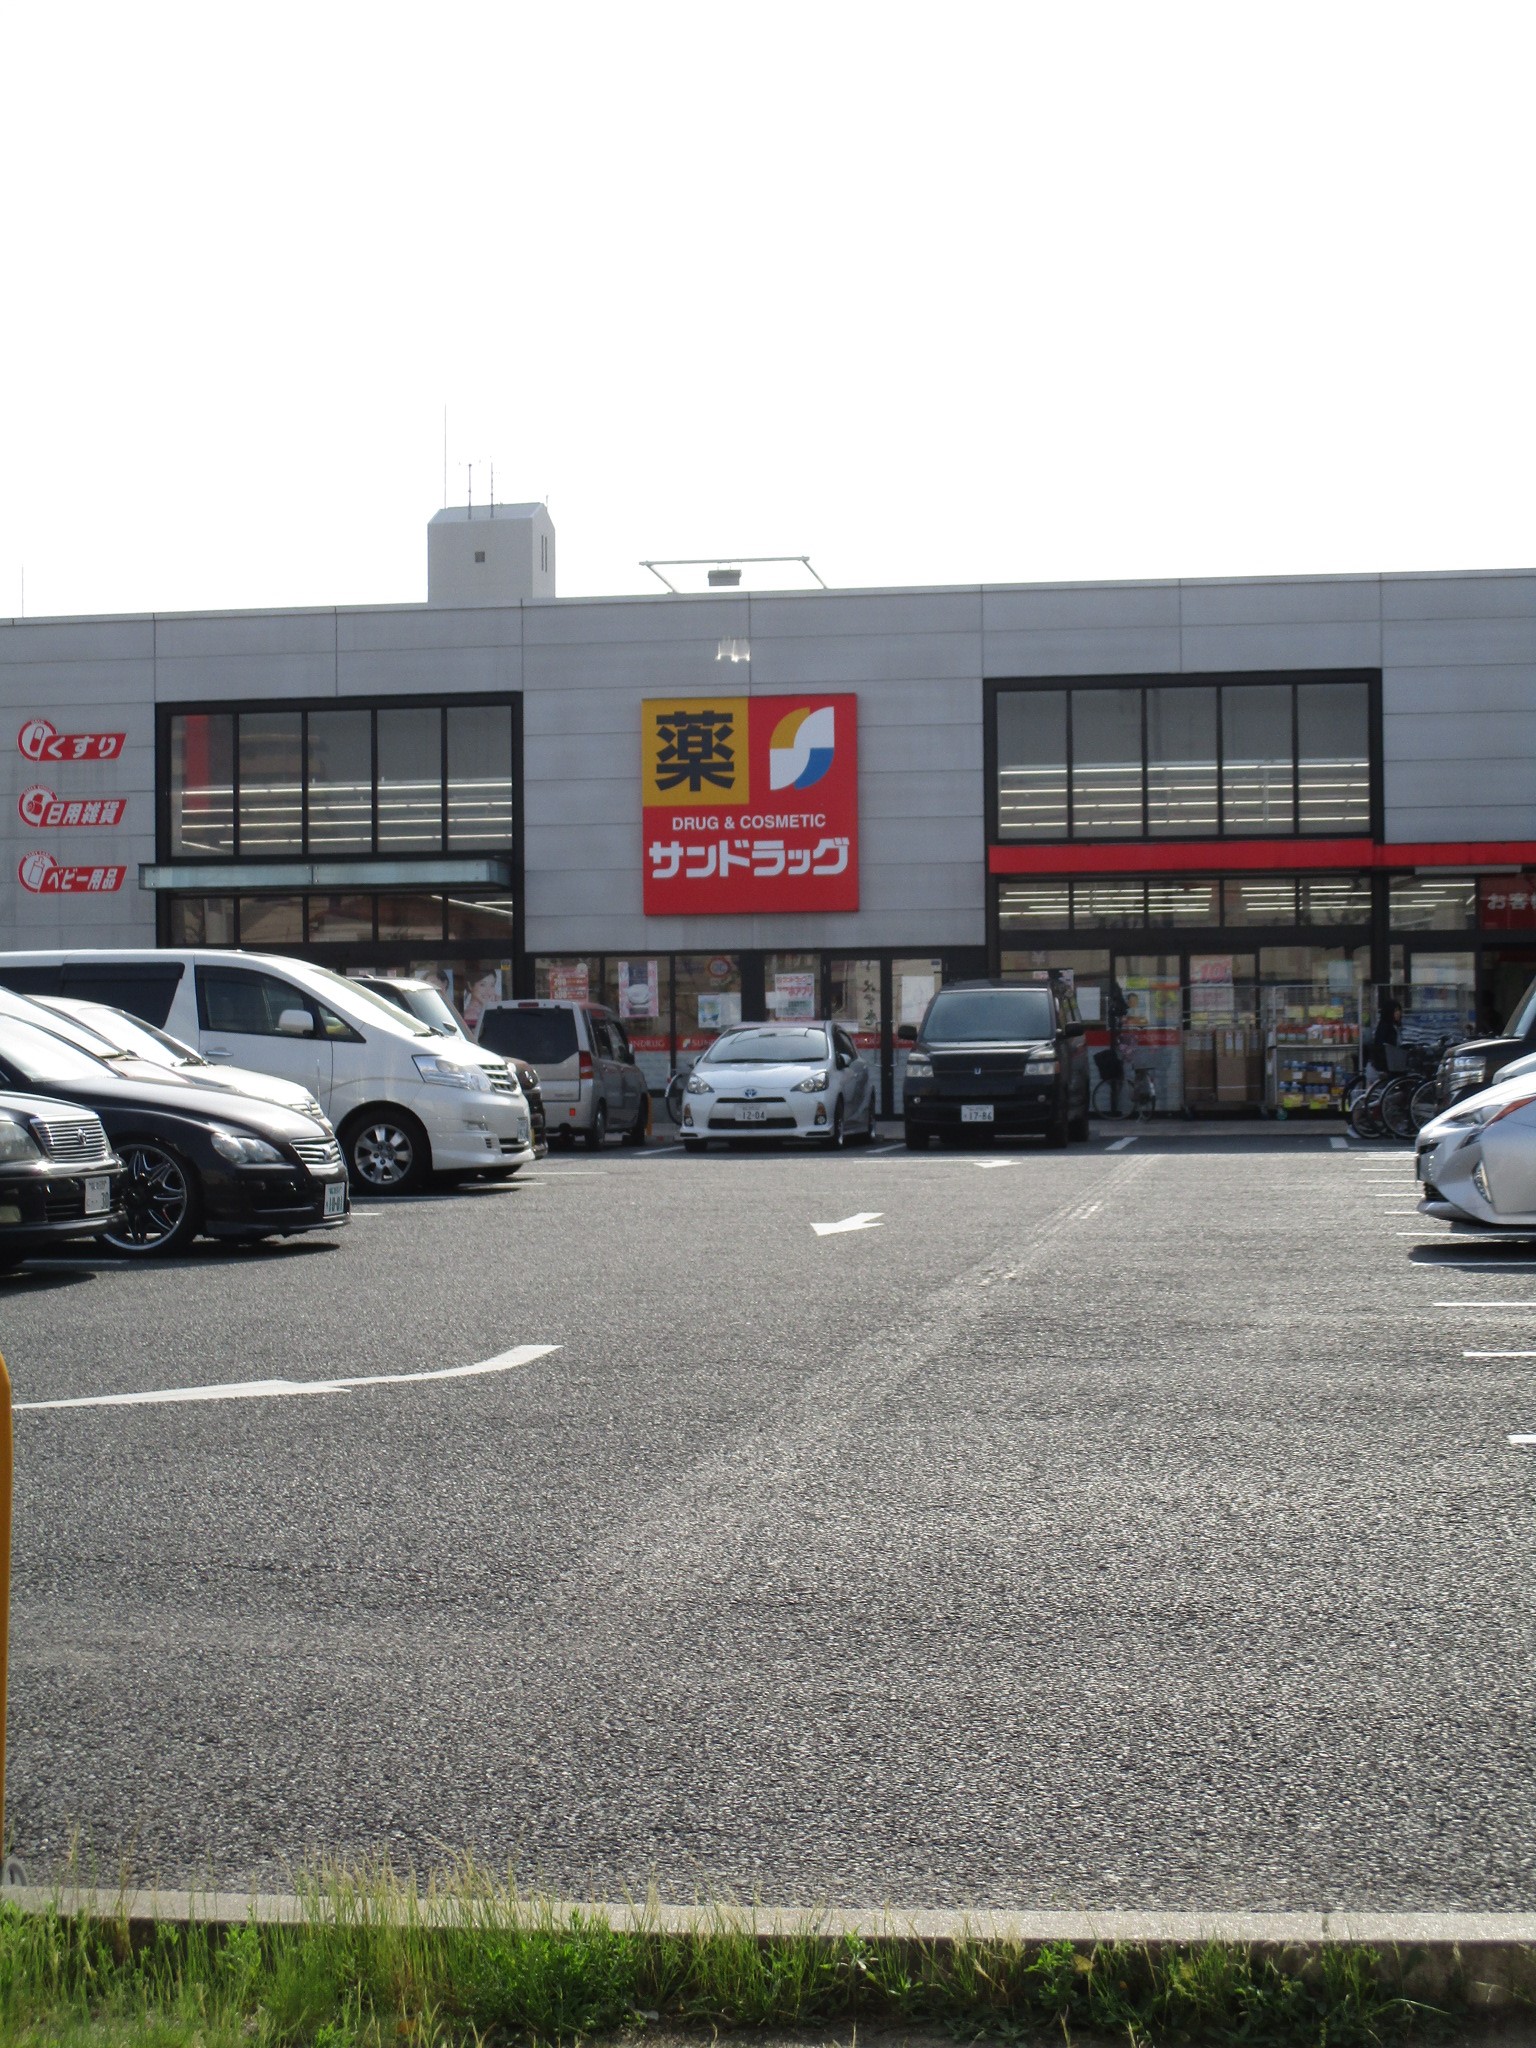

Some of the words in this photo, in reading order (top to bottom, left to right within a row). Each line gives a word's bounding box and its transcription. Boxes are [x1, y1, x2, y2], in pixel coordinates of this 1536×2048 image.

[47, 735, 117, 759] くすり
[654, 710, 736, 792] 薬
[46, 801, 120, 825] 日用雑貨
[672, 816, 719, 831] DRUG
[724, 816, 736, 830] &
[740, 813, 826, 829] COSMETIC
[649, 837, 850, 879] サンドラッグ
[47, 868, 118, 890] ベビー用品
